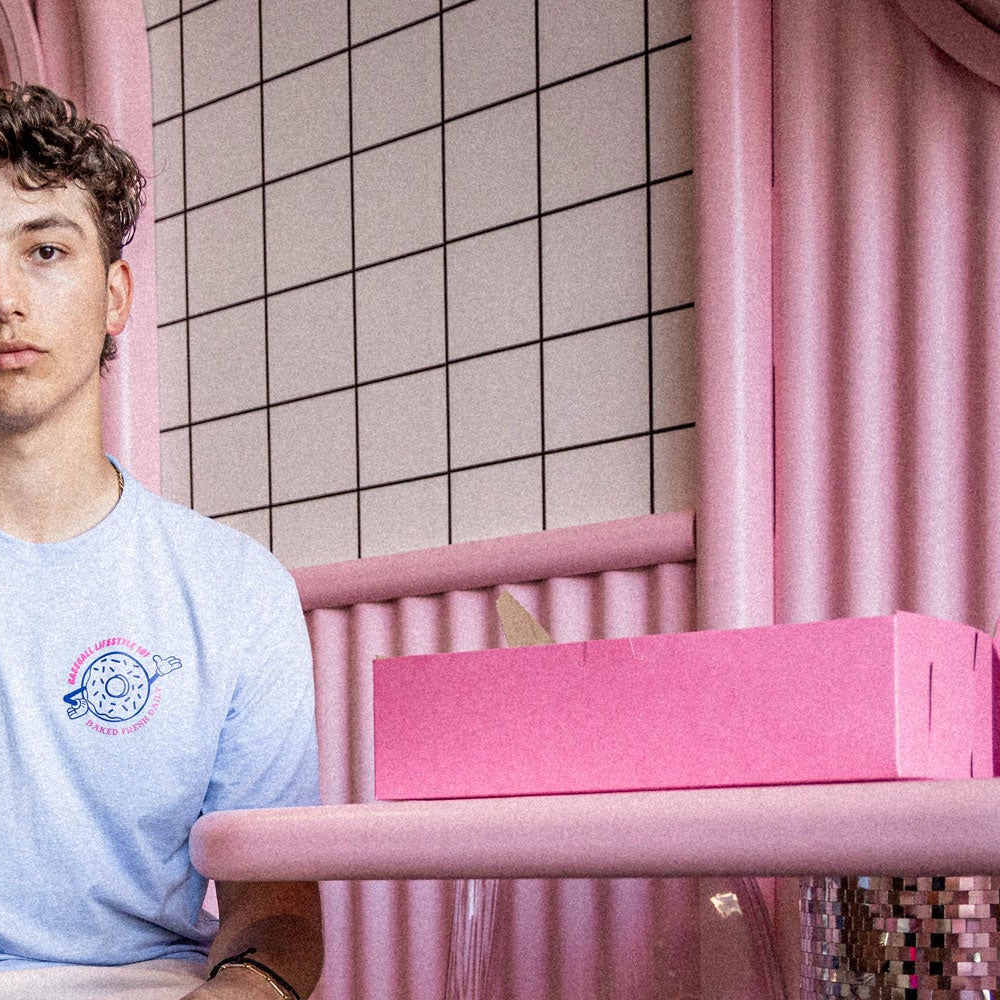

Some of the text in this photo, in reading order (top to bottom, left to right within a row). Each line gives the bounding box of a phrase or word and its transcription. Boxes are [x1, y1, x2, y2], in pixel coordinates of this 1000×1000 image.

[68, 647, 94, 685] BASEBALL
[94, 637, 136, 651] LIFESTYLE
[86, 686, 162, 736] BAKED FRESH DAILY
